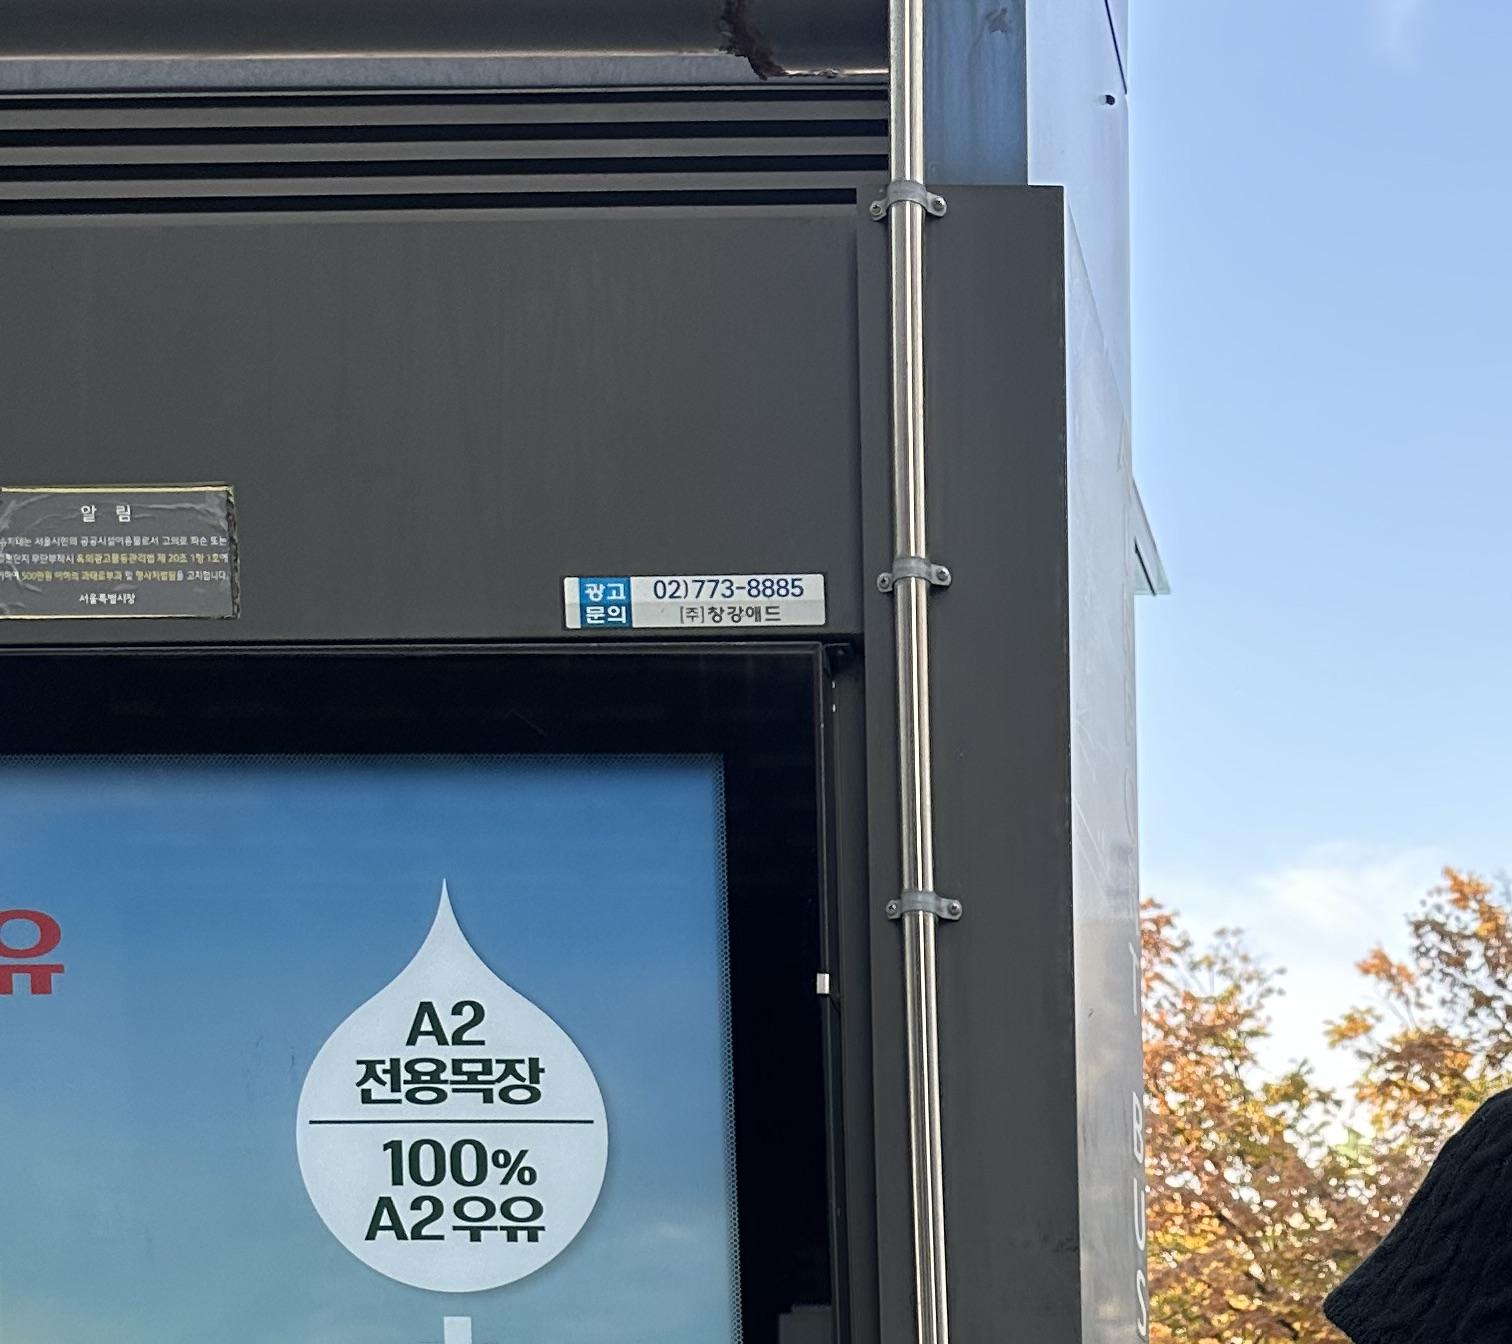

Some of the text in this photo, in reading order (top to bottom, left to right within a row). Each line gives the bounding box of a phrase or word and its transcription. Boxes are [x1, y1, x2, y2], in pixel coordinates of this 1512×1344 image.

[79, 593, 136, 605] 서울특별시장
[585, 582, 626, 602] 광고
[653, 578, 804, 600] 02)773-8885
[585, 605, 626, 624] 문의
[405, 1000, 487, 1047] A2
[355, 1056, 546, 1106] 전용목장
[382, 1138, 538, 1187] 100%
[364, 1195, 546, 1244] A2우유
[1133, 1091, 1147, 1337] BUS
